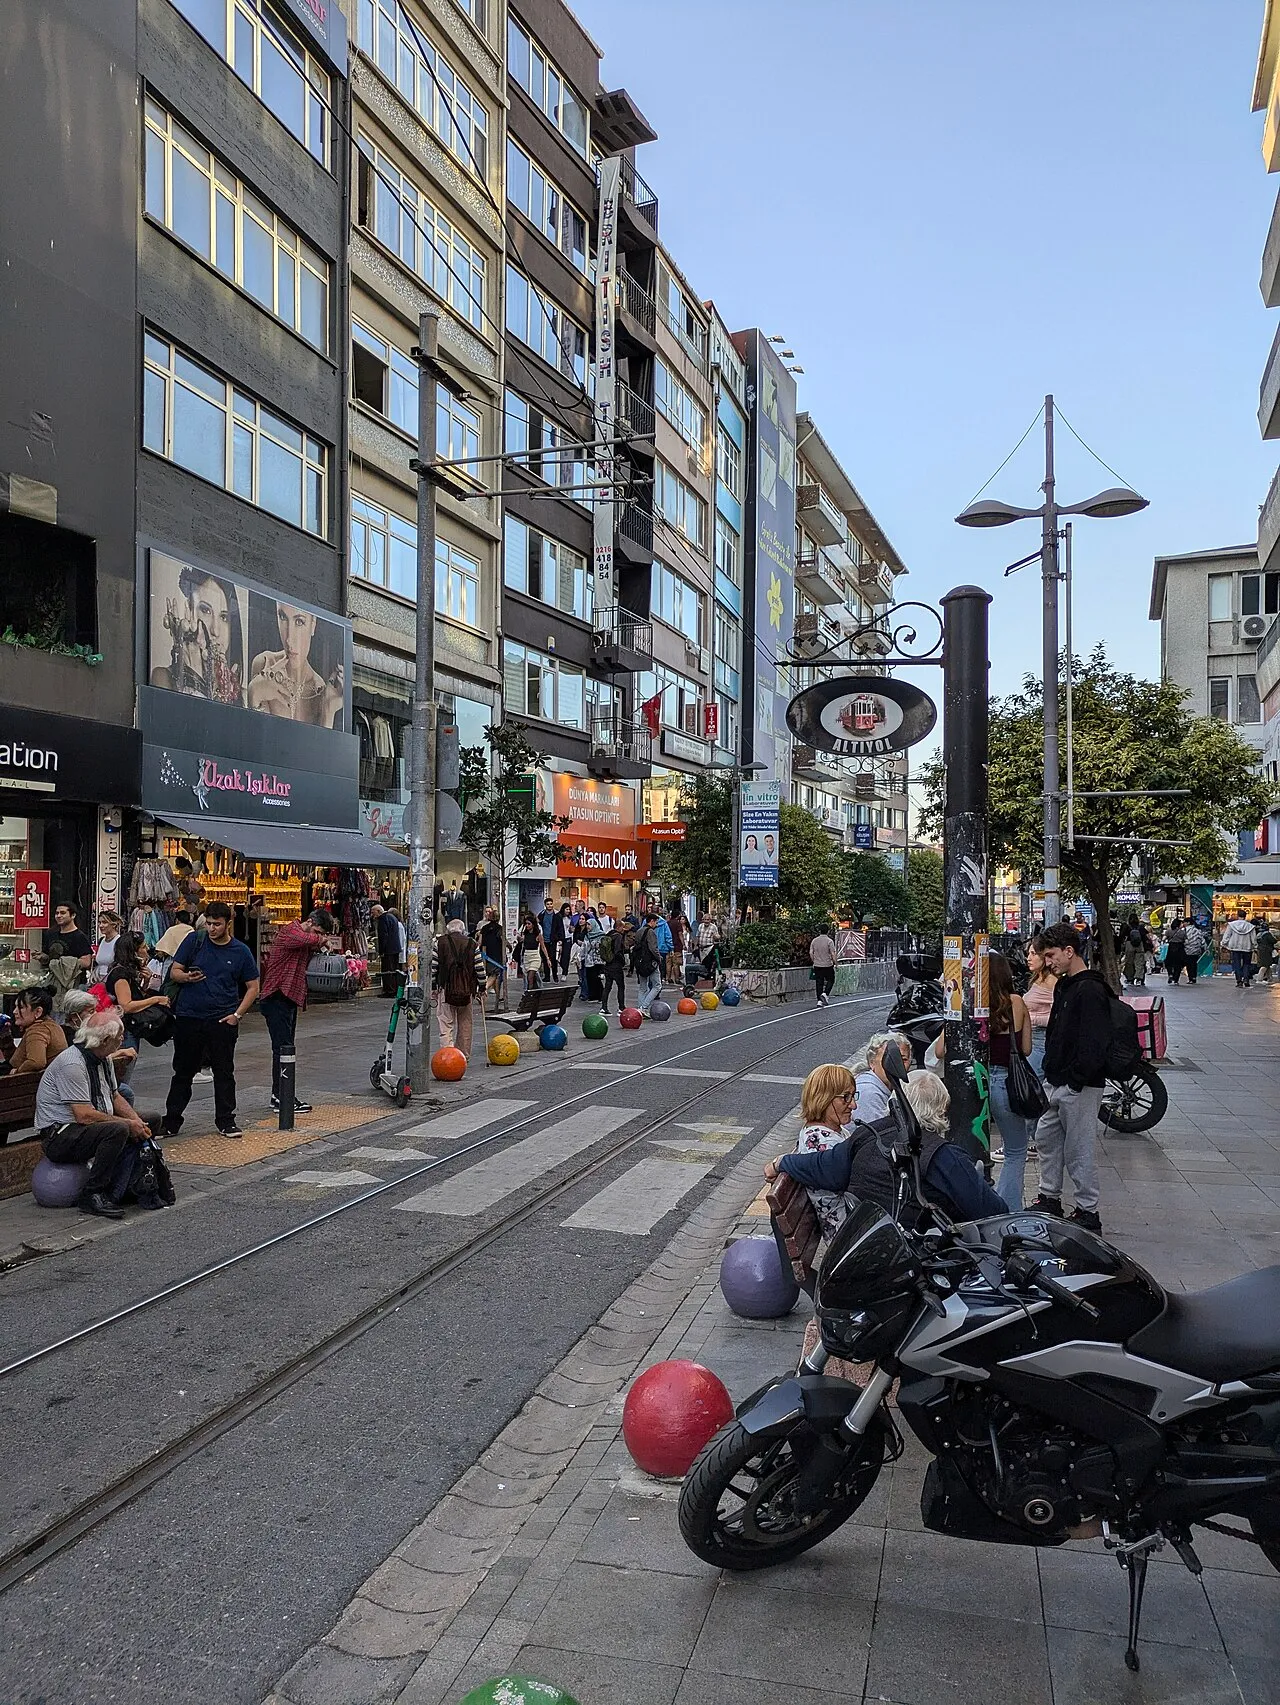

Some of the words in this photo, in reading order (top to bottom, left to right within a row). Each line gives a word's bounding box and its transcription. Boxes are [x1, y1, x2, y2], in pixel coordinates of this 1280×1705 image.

[599, 197, 614, 379] BRITISH
[595, 545, 612, 554] 0216
[595, 553, 612, 563] 418
[598, 562, 610, 571] 84
[598, 571, 610, 580] 54
[832, 737, 893, 754] ALTIYOL
[203, 759, 245, 792] Uzak
[245, 770, 292, 797] Işıklar
[262, 796, 291, 807] Accessories
[568, 786, 589, 801] DÜNYA
[589, 792, 620, 807] MARKALARI
[757, 793, 779, 801] vitro
[568, 805, 594, 821] ATASUN
[612, 848, 638, 875] Optik
[34, 893, 46, 906] AL
[25, 903, 44, 917] ÖDE
